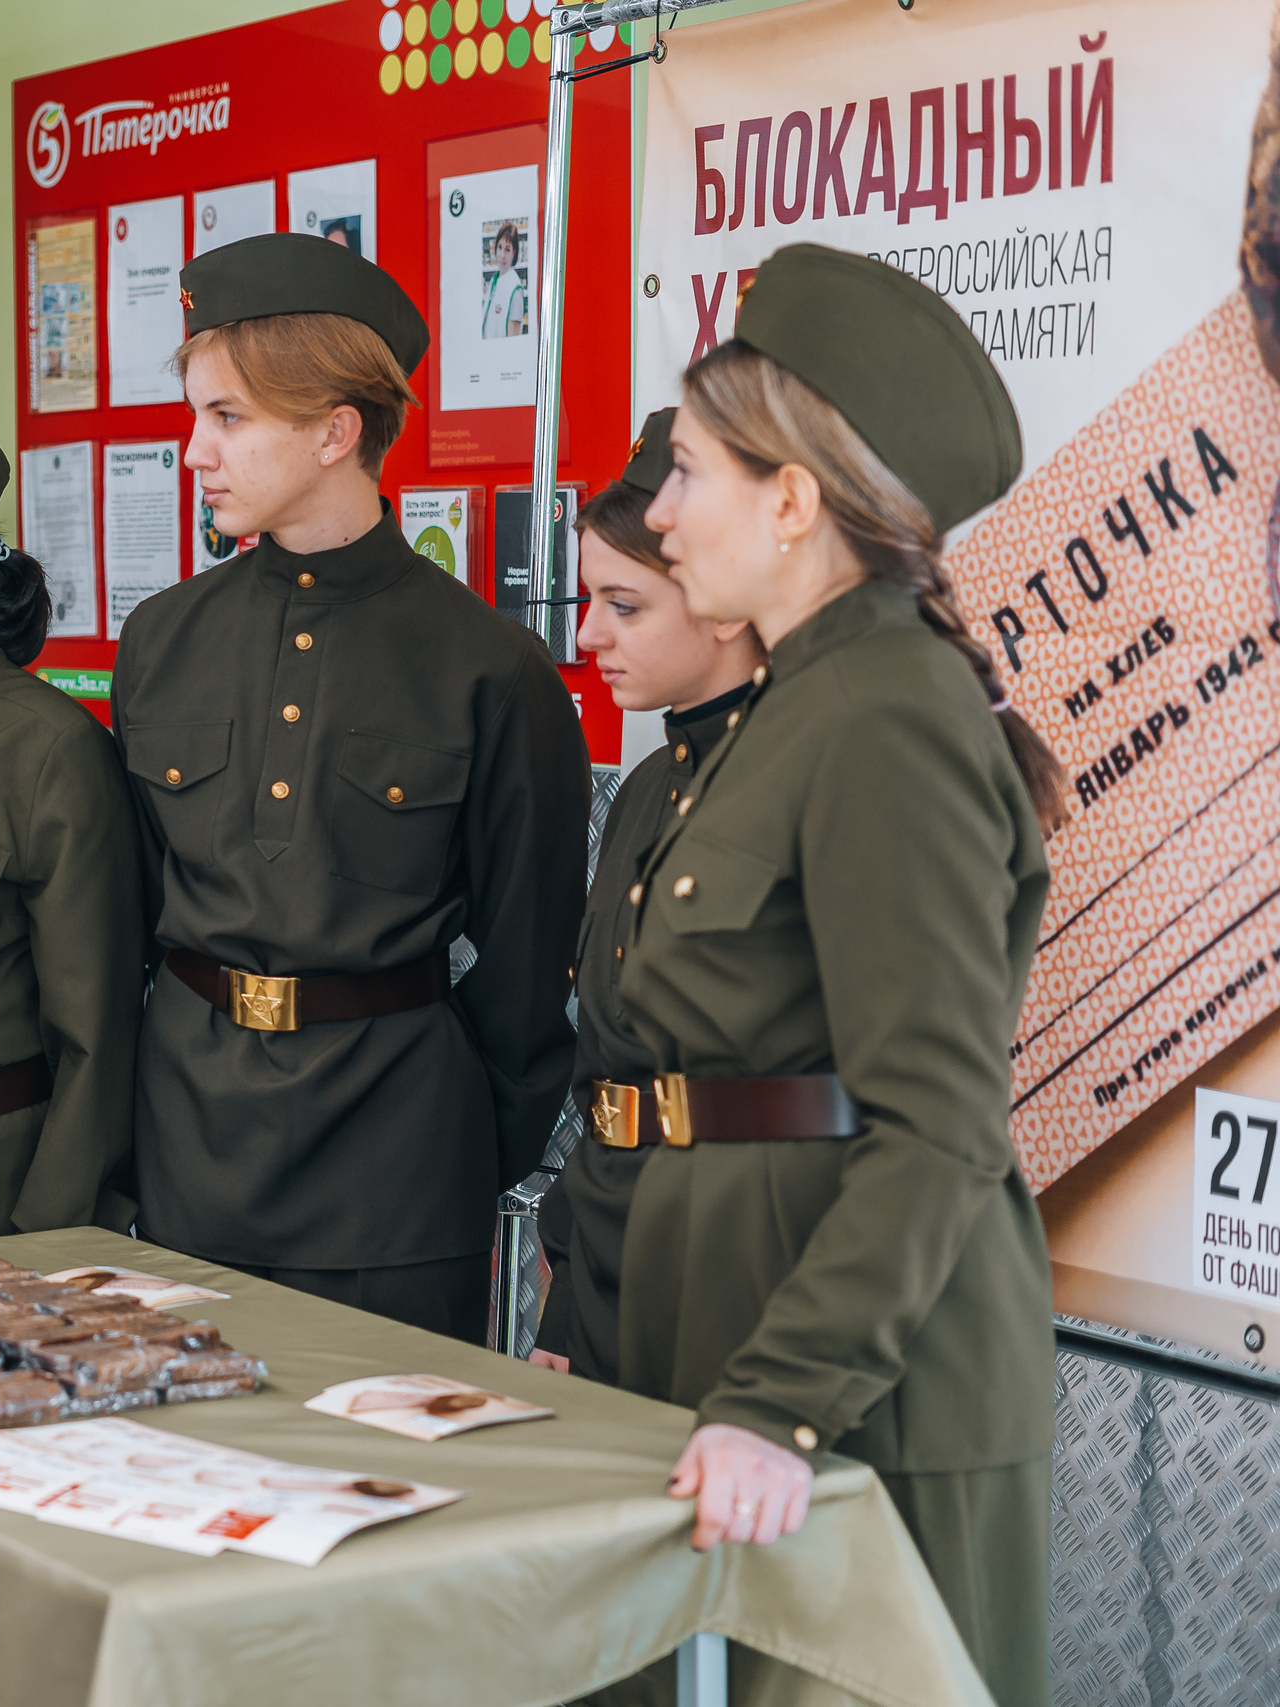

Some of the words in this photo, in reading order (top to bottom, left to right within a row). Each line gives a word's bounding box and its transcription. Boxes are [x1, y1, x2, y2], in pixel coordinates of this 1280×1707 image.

[168, 81, 230, 104] УНИВЕРСАМ
[693, 30, 1114, 236] БЛОКАДНЫЙ
[867, 226, 1112, 297] ЕРОССИЙСКАЯ
[406, 501, 419, 509] Есть
[419, 509, 444, 519] вопрос?
[991, 427, 1238, 673] РТОЧКА
[1063, 679, 1103, 719] НА
[1106, 615, 1176, 685] ХЛЕБ
[1075, 702, 1190, 808] ЯНВАРЬ
[1195, 633, 1264, 704] 1942
[1093, 1073, 1130, 1107] При
[1210, 1110, 1278, 1205] 27
[1203, 1212, 1252, 1250] ДЕНЬ
[1203, 1252, 1225, 1285] ОТ
[1230, 1259, 1280, 1297] ФАШ
